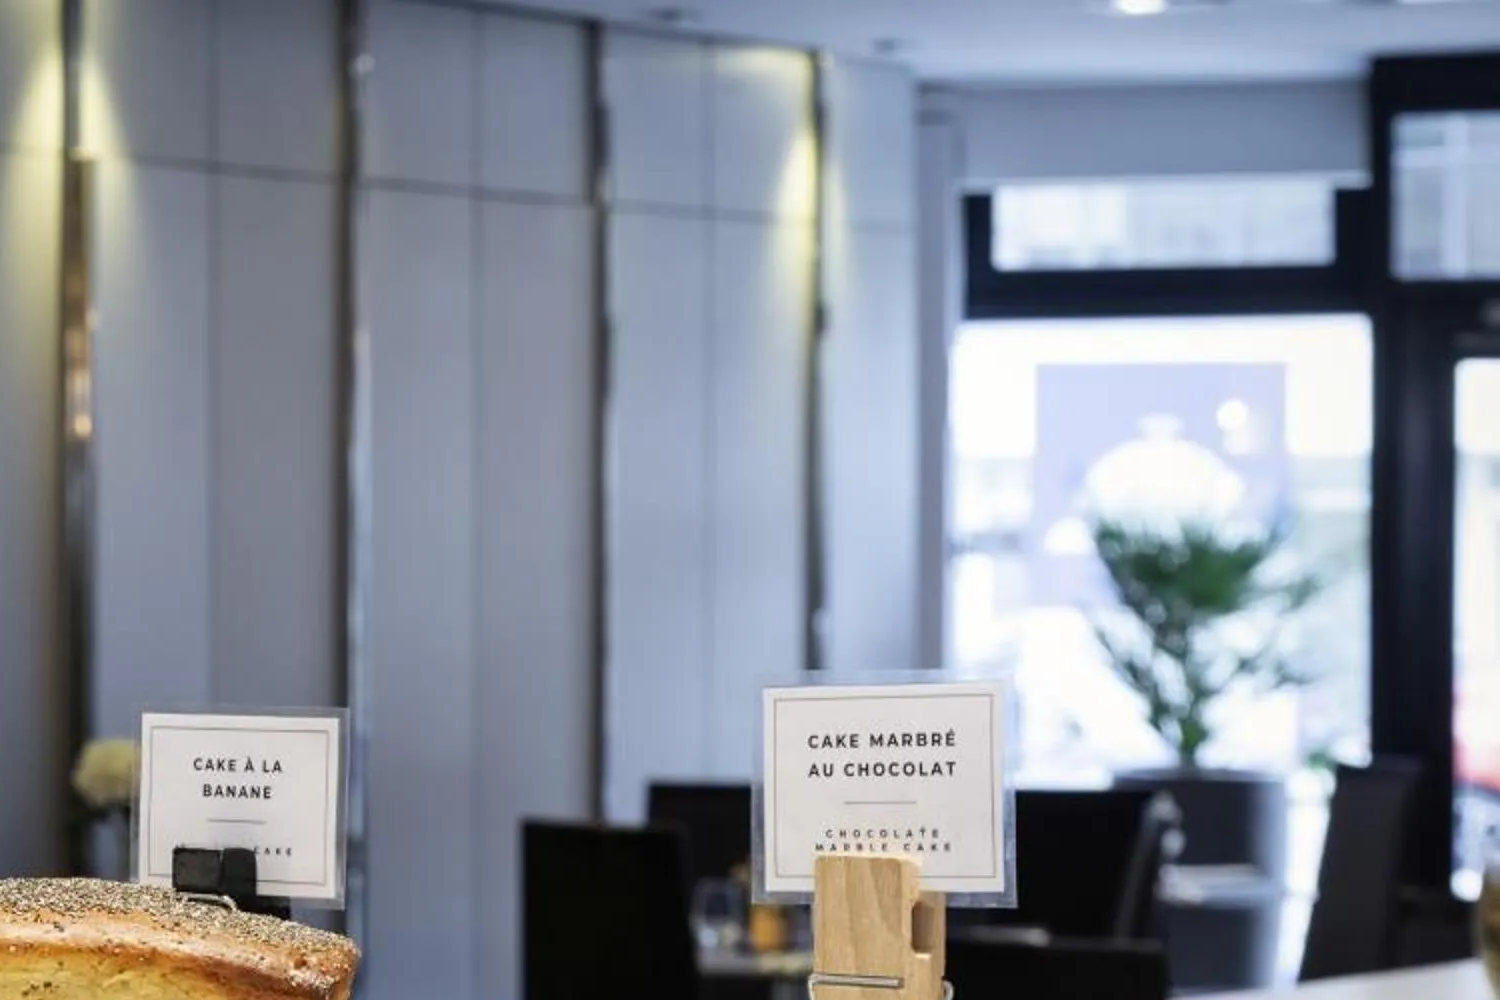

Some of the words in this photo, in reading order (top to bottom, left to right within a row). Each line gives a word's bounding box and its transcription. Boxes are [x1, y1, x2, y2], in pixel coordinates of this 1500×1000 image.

[807, 734, 860, 750] CAKE
[869, 729, 957, 748] MARBRÉ
[192, 757, 237, 773] CAKE
[243, 756, 254, 773] À
[262, 759, 283, 774] LA
[807, 763, 835, 778] AU
[843, 761, 958, 777] CHOCOLAT
[202, 783, 273, 800] BANANE
[825, 827, 940, 839] CHOCOLATE
[902, 842, 953, 853] CAKE
